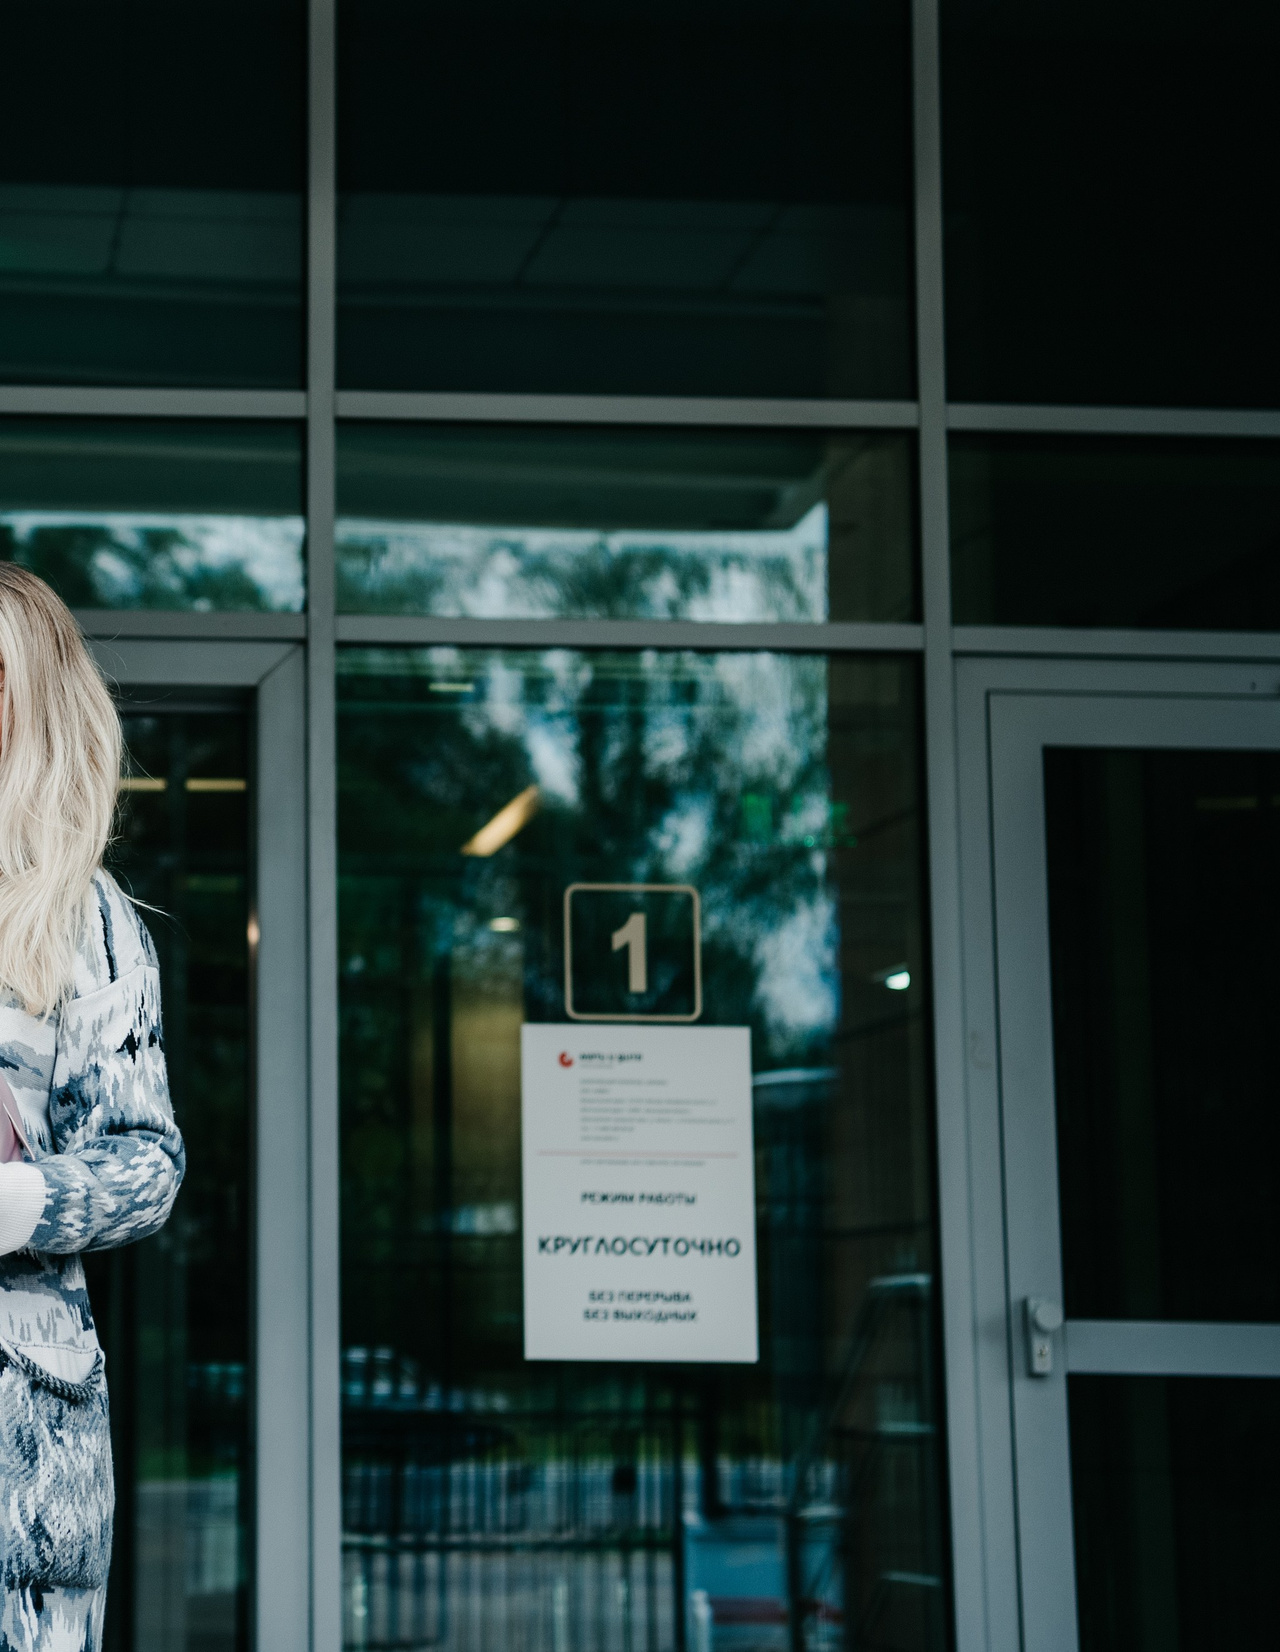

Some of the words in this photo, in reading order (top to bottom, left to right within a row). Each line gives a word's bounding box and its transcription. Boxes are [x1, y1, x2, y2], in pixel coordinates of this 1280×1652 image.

[612, 913, 647, 993] 1
[581, 1191, 634, 1203] РЕЖИМ
[639, 1192, 696, 1205] РАБОТЫ
[538, 1236, 741, 1257] КРУГЛОСУТОЧНО
[589, 1291, 614, 1303] БЕЗ
[618, 1291, 691, 1303] ПЕРЕРЫВА
[583, 1309, 609, 1321] БЕЗ
[613, 1309, 697, 1323] ВЫХОДНЫХ
